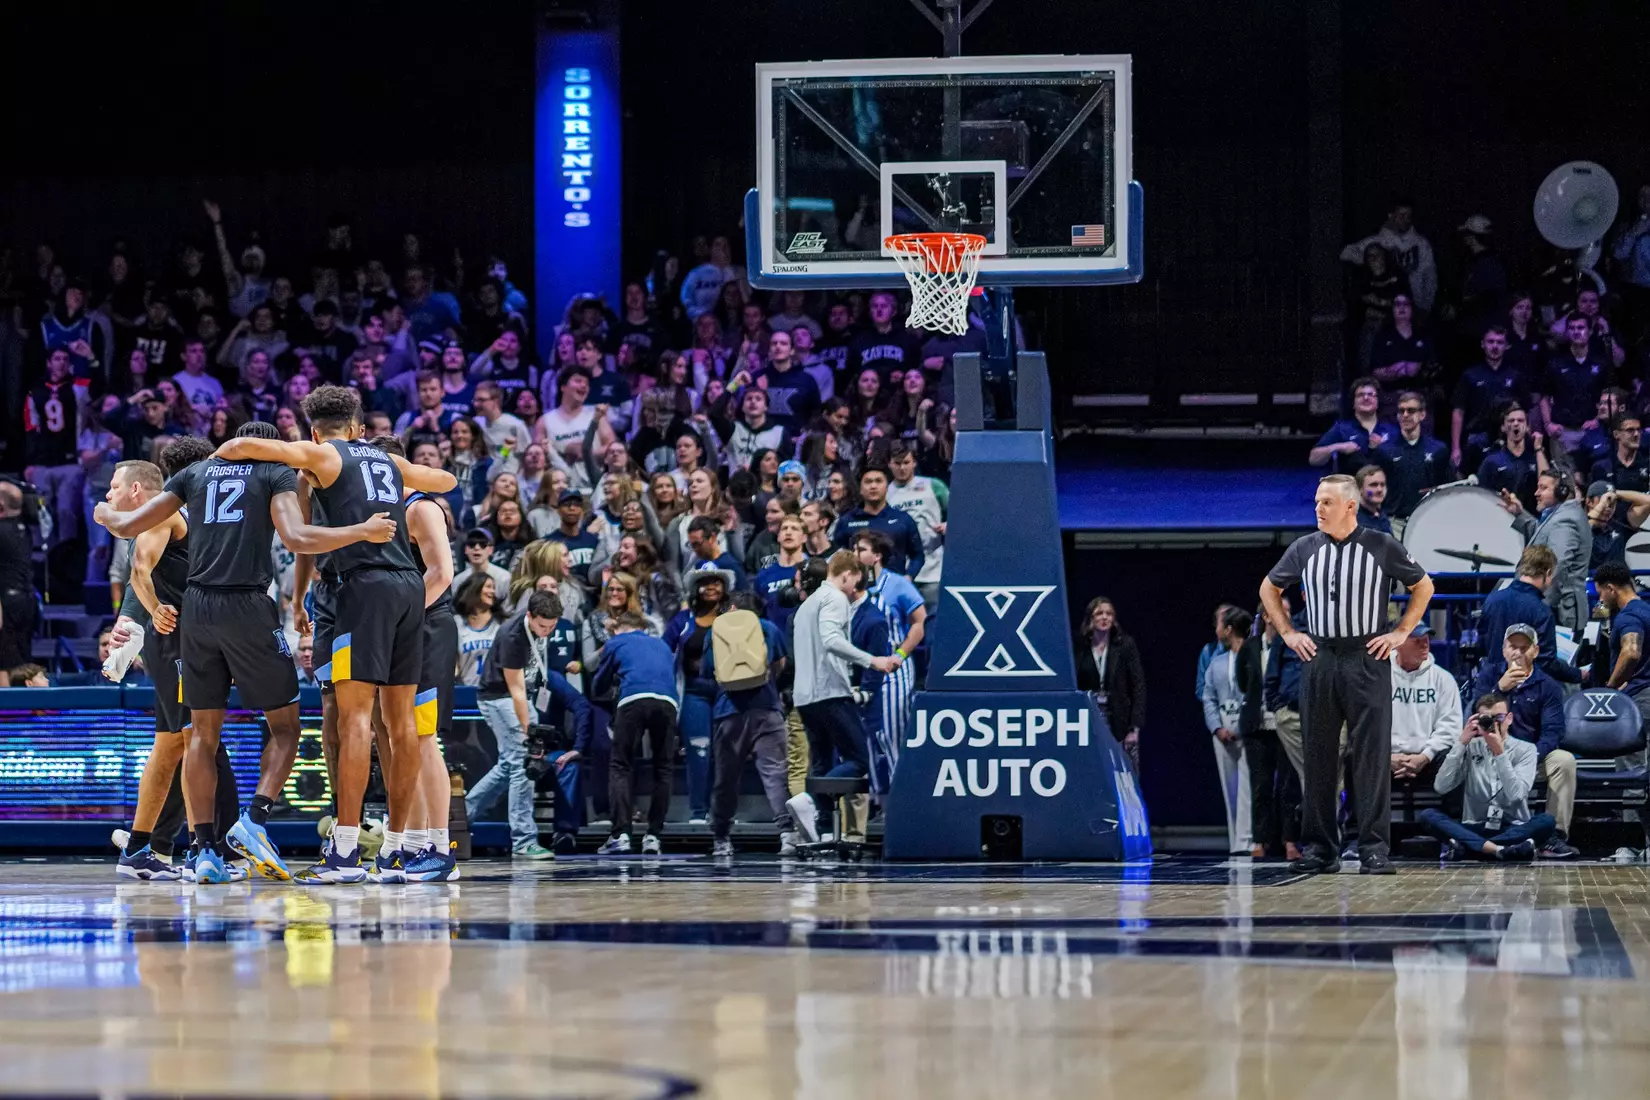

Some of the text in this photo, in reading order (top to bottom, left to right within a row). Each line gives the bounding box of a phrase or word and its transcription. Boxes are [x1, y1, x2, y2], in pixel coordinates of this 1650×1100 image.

[562, 68, 593, 227] SORRENTO'S
[790, 240, 827, 248] EAST
[773, 265, 808, 273] SPALDING
[861, 345, 904, 366] XAVIER
[44, 400, 65, 432] 9
[205, 464, 252, 477] PROSPER
[359, 461, 399, 504] 13
[203, 479, 245, 524] 12
[463, 639, 492, 654] XAVIE
[1392, 687, 1436, 703] AVIER
[906, 708, 1089, 748] JOSEPH
[932, 758, 1067, 797] AUTO
